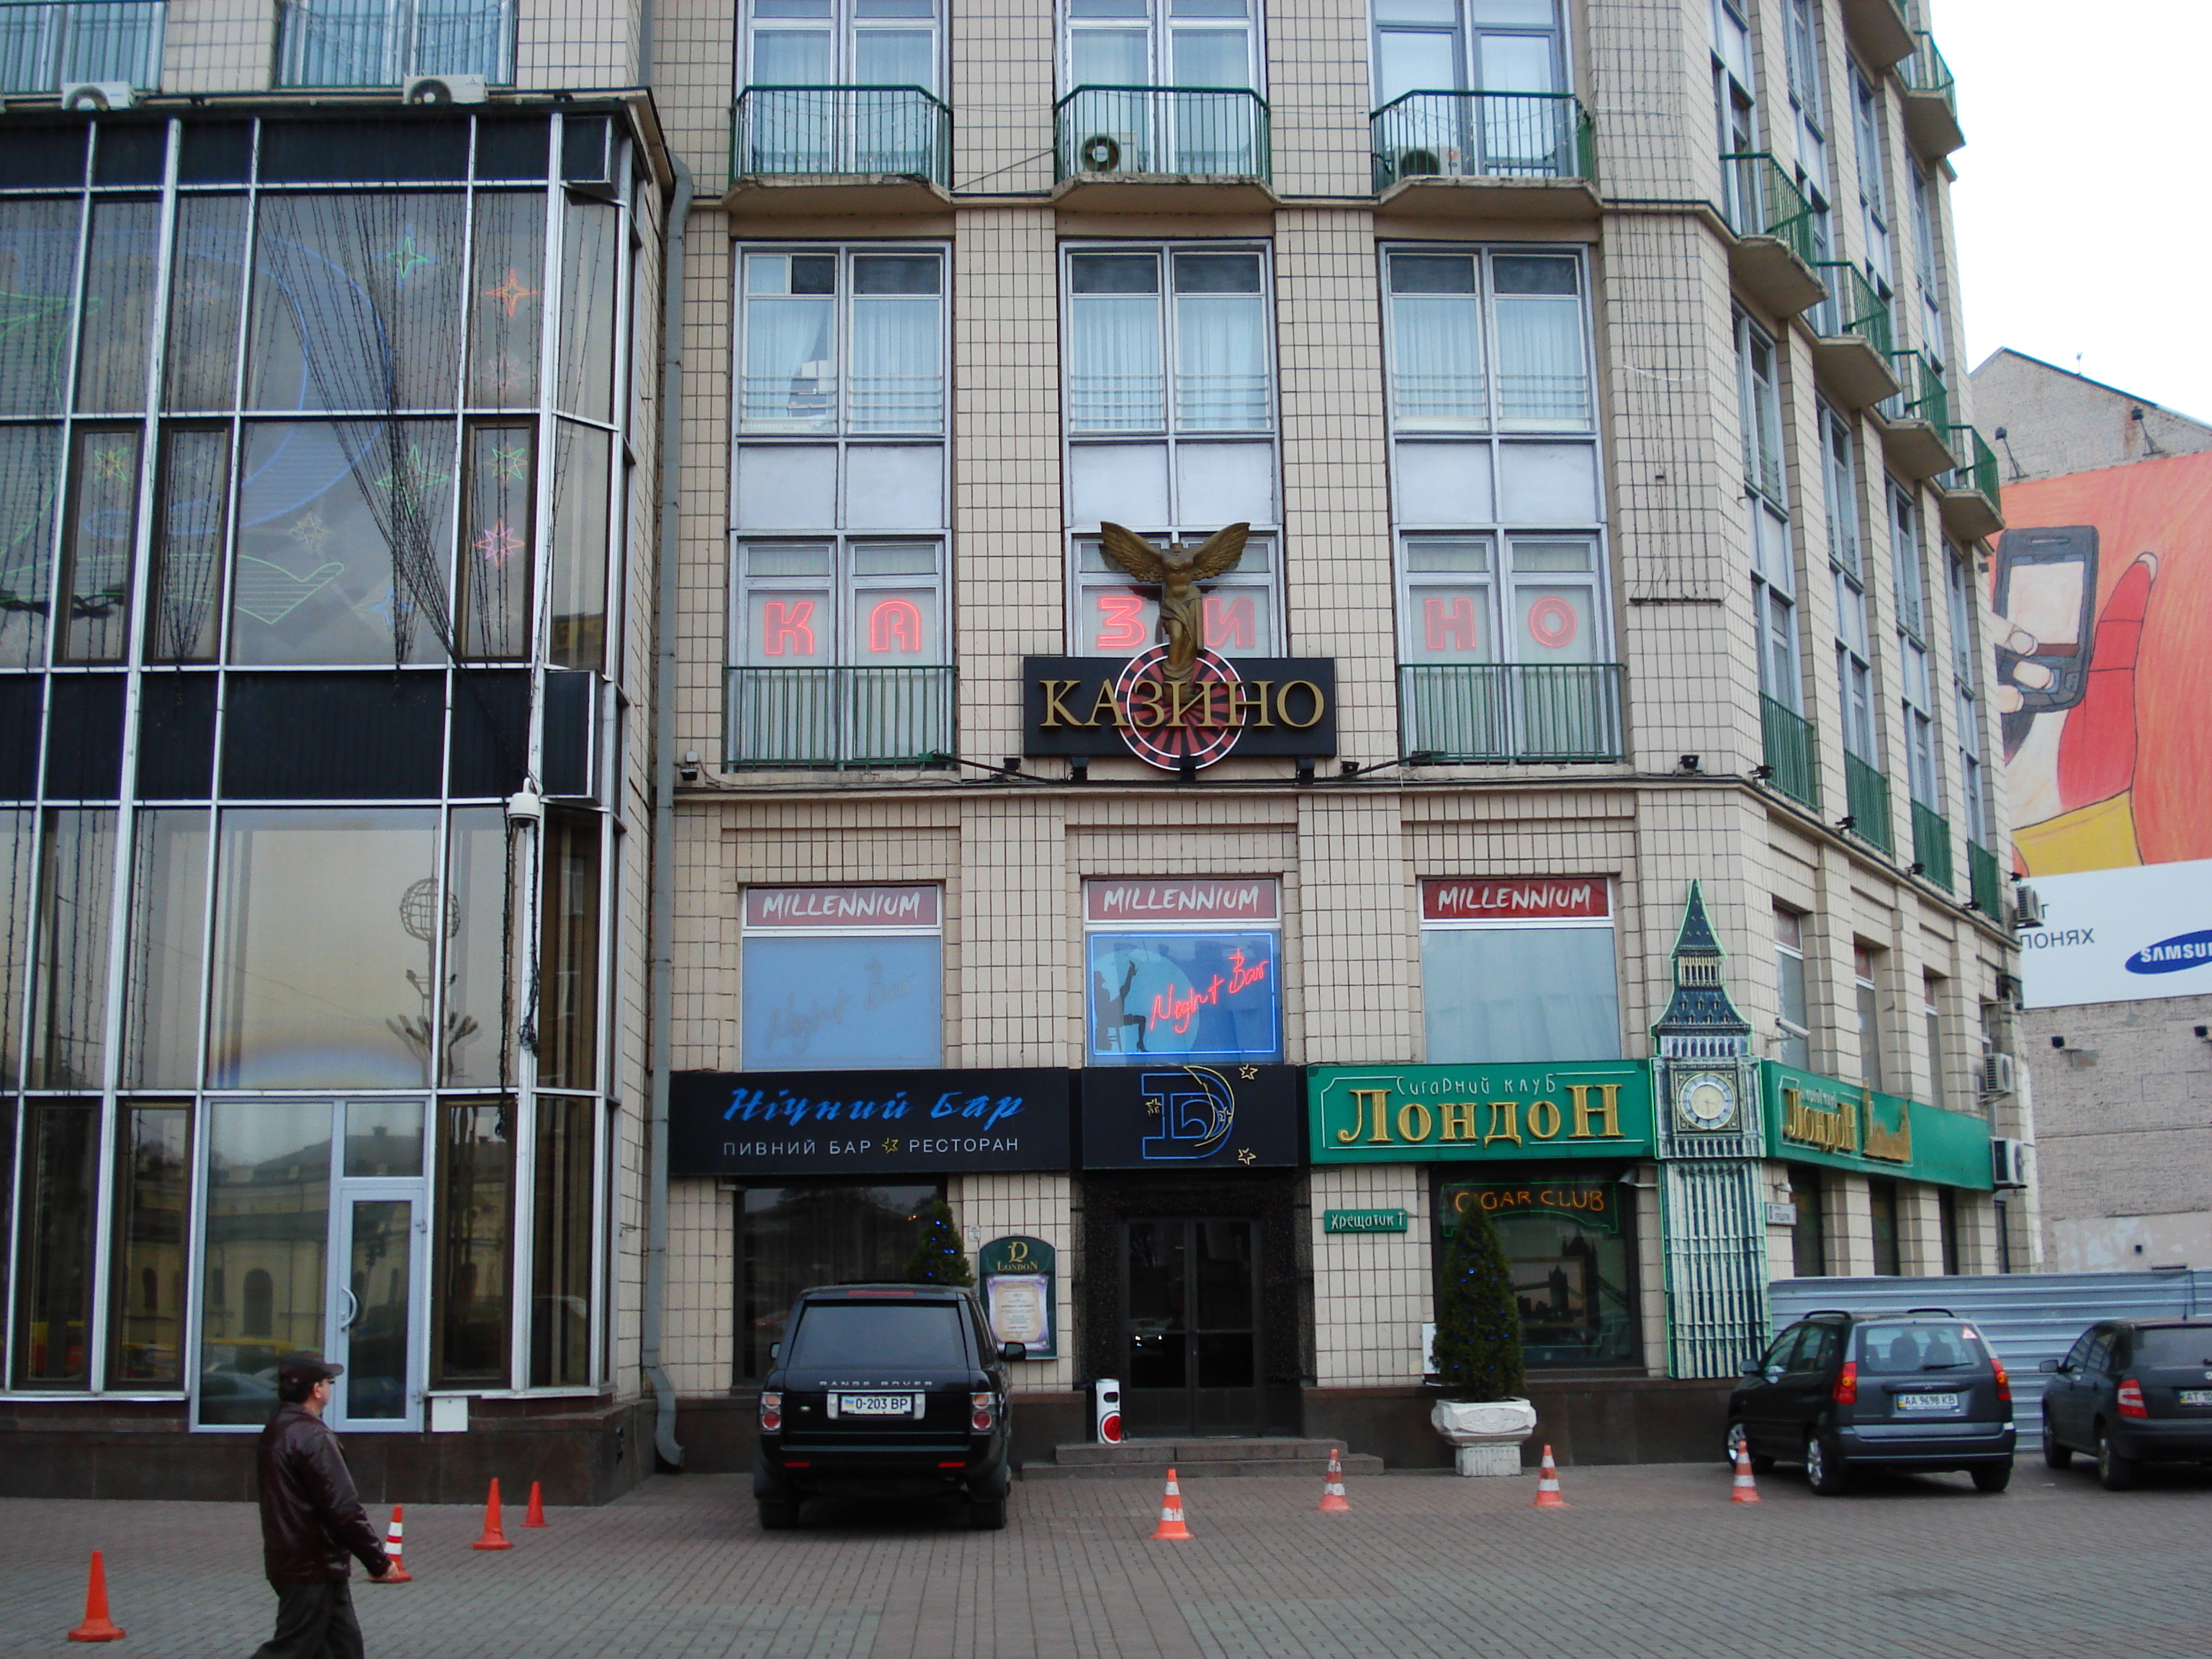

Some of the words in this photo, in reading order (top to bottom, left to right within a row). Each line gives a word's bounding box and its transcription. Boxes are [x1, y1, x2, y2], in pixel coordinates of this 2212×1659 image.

[1039, 678, 1326, 729] КАЗИНО
[762, 890, 921, 920] MILLENNIUM
[1103, 884, 1259, 914] MILLENNIUM
[1438, 883, 1591, 914] MILLENNIUM
[1149, 974, 1224, 1034] Night
[1228, 948, 1270, 994] Bar
[723, 1087, 909, 1126] Нічний
[930, 1091, 1027, 1132] Бар
[723, 1140, 817, 1156] ПИВНИЙ
[829, 1140, 871, 1154] БАР
[909, 1138, 1019, 1152] РЕСТОРАН
[1455, 1191, 1532, 1213] CGAR
[1541, 1190, 1604, 1211] CLUB
